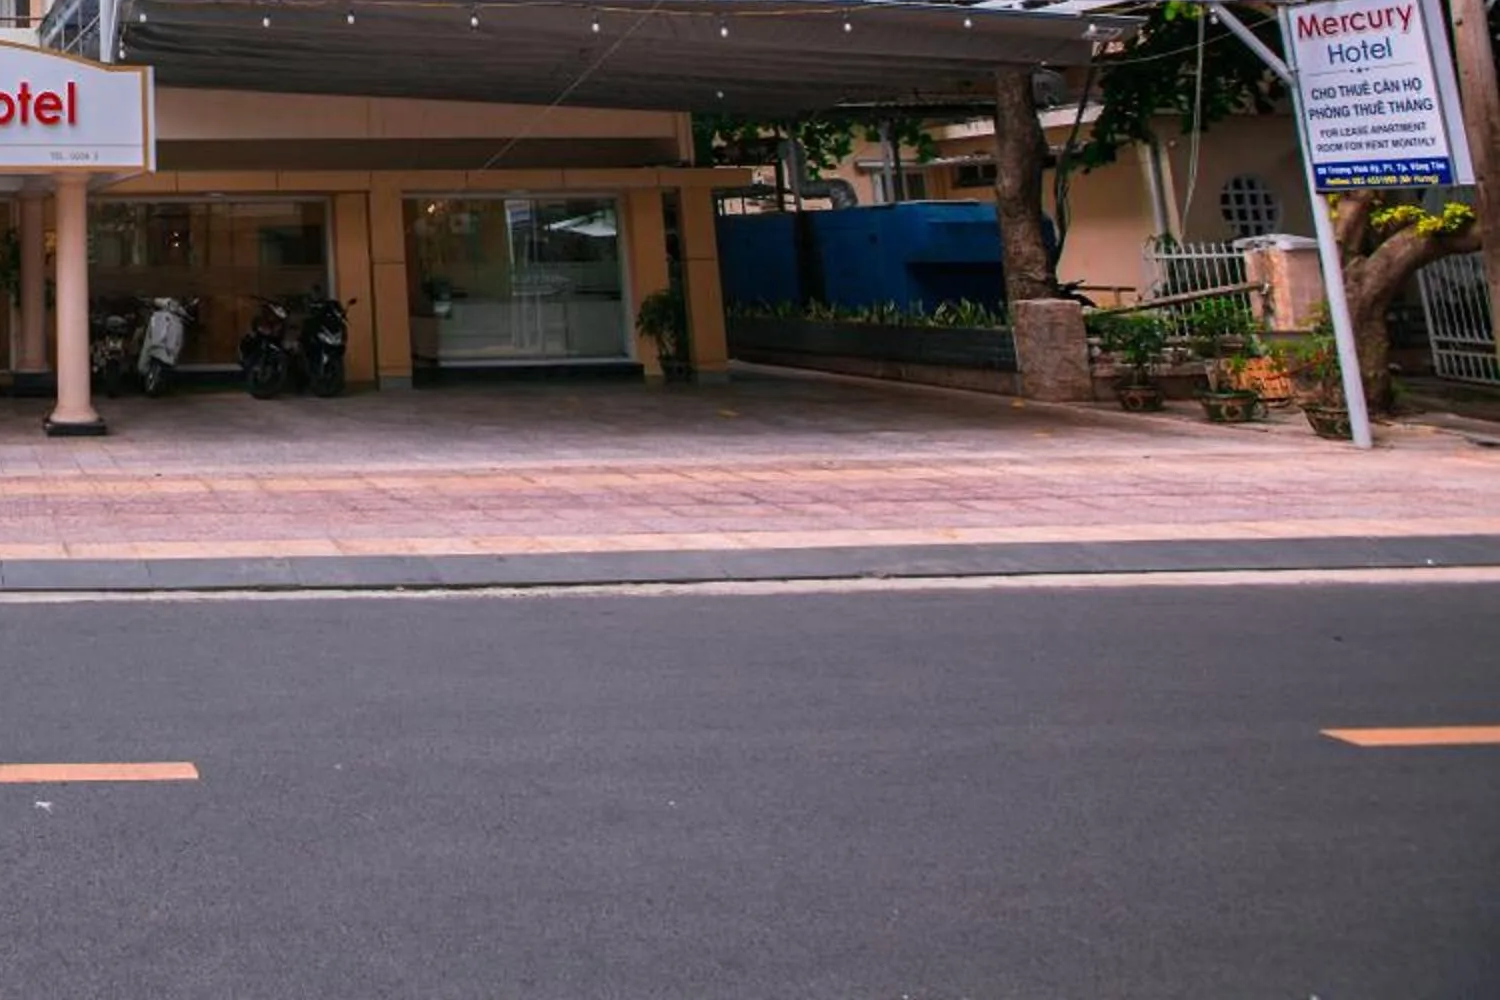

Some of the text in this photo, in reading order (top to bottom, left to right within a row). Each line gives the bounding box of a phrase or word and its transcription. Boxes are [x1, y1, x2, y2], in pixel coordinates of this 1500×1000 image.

[1297, 4, 1412, 39] Mercury
[1327, 37, 1393, 65] Hotel
[1311, 86, 1337, 100] CHO
